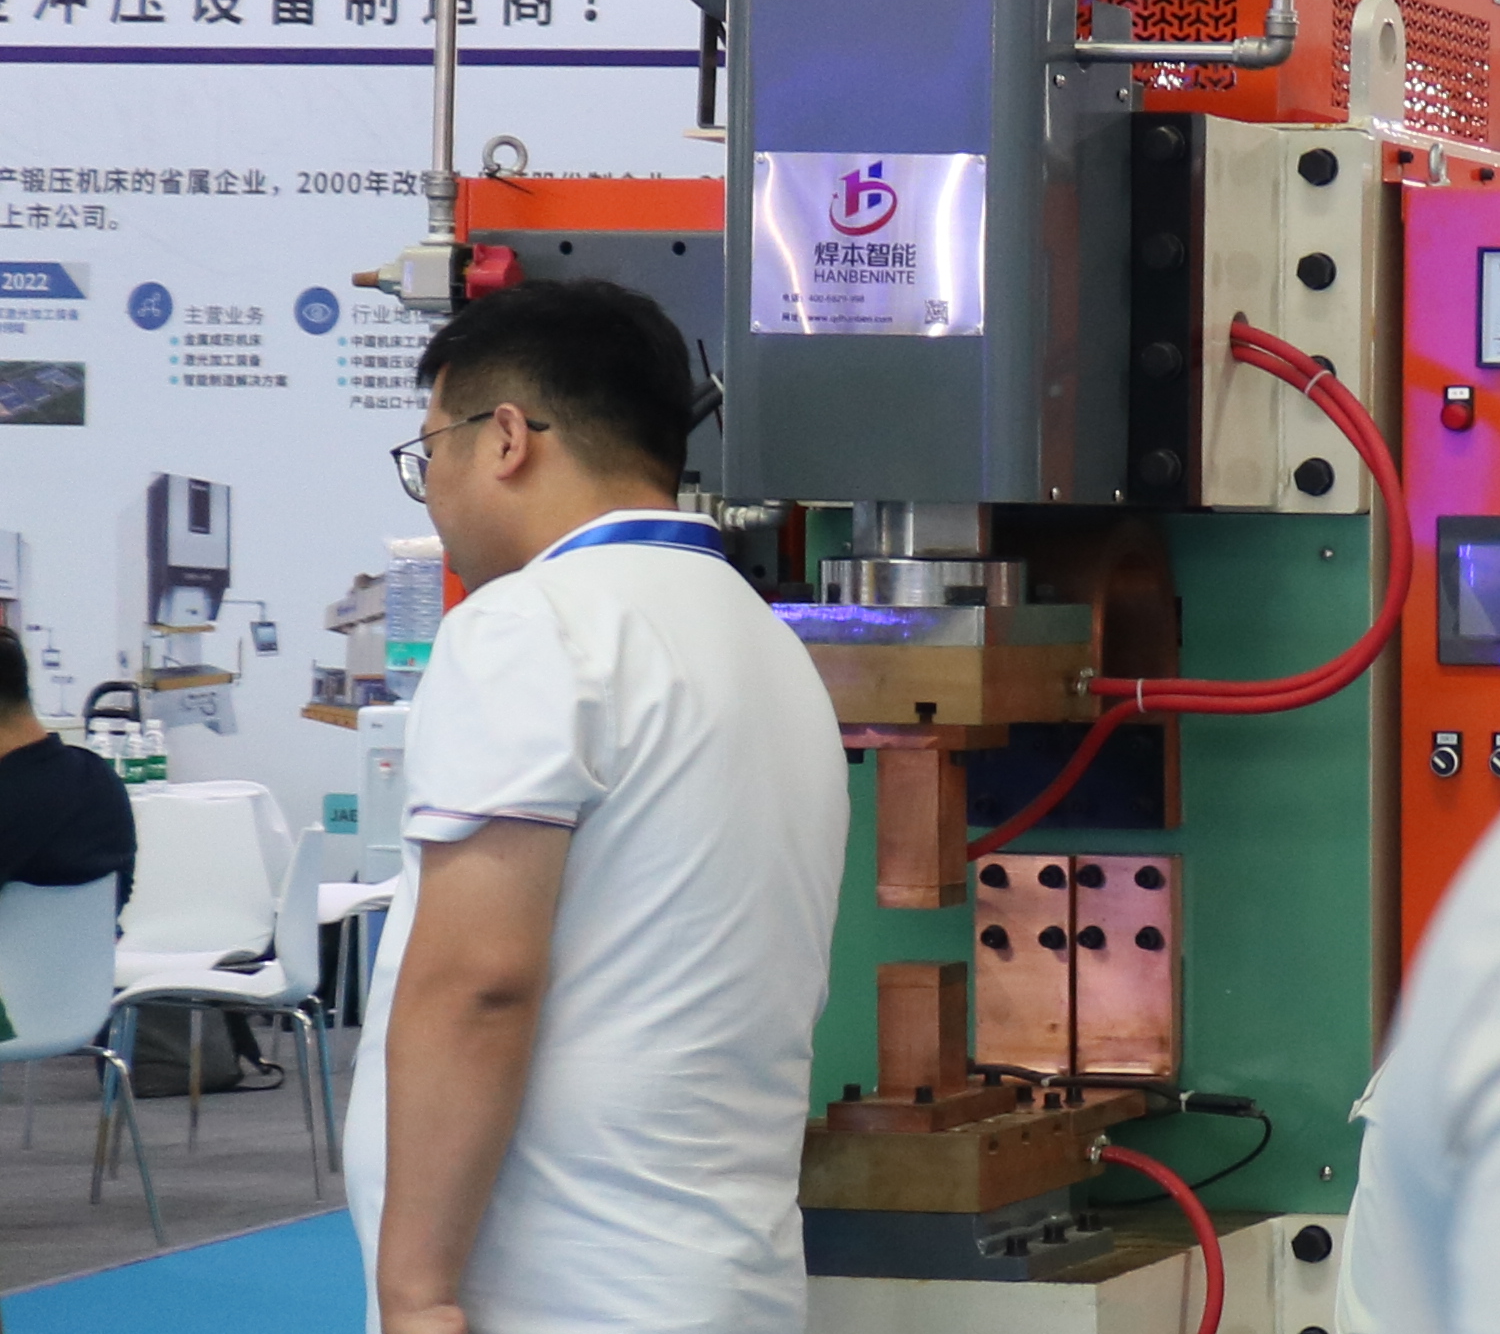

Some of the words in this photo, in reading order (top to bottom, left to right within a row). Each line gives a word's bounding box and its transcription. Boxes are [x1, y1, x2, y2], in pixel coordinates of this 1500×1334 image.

[814, 241, 917, 268] 焊本智能
[2, 272, 49, 291] 2022
[813, 269, 915, 285] HANBENINTE
